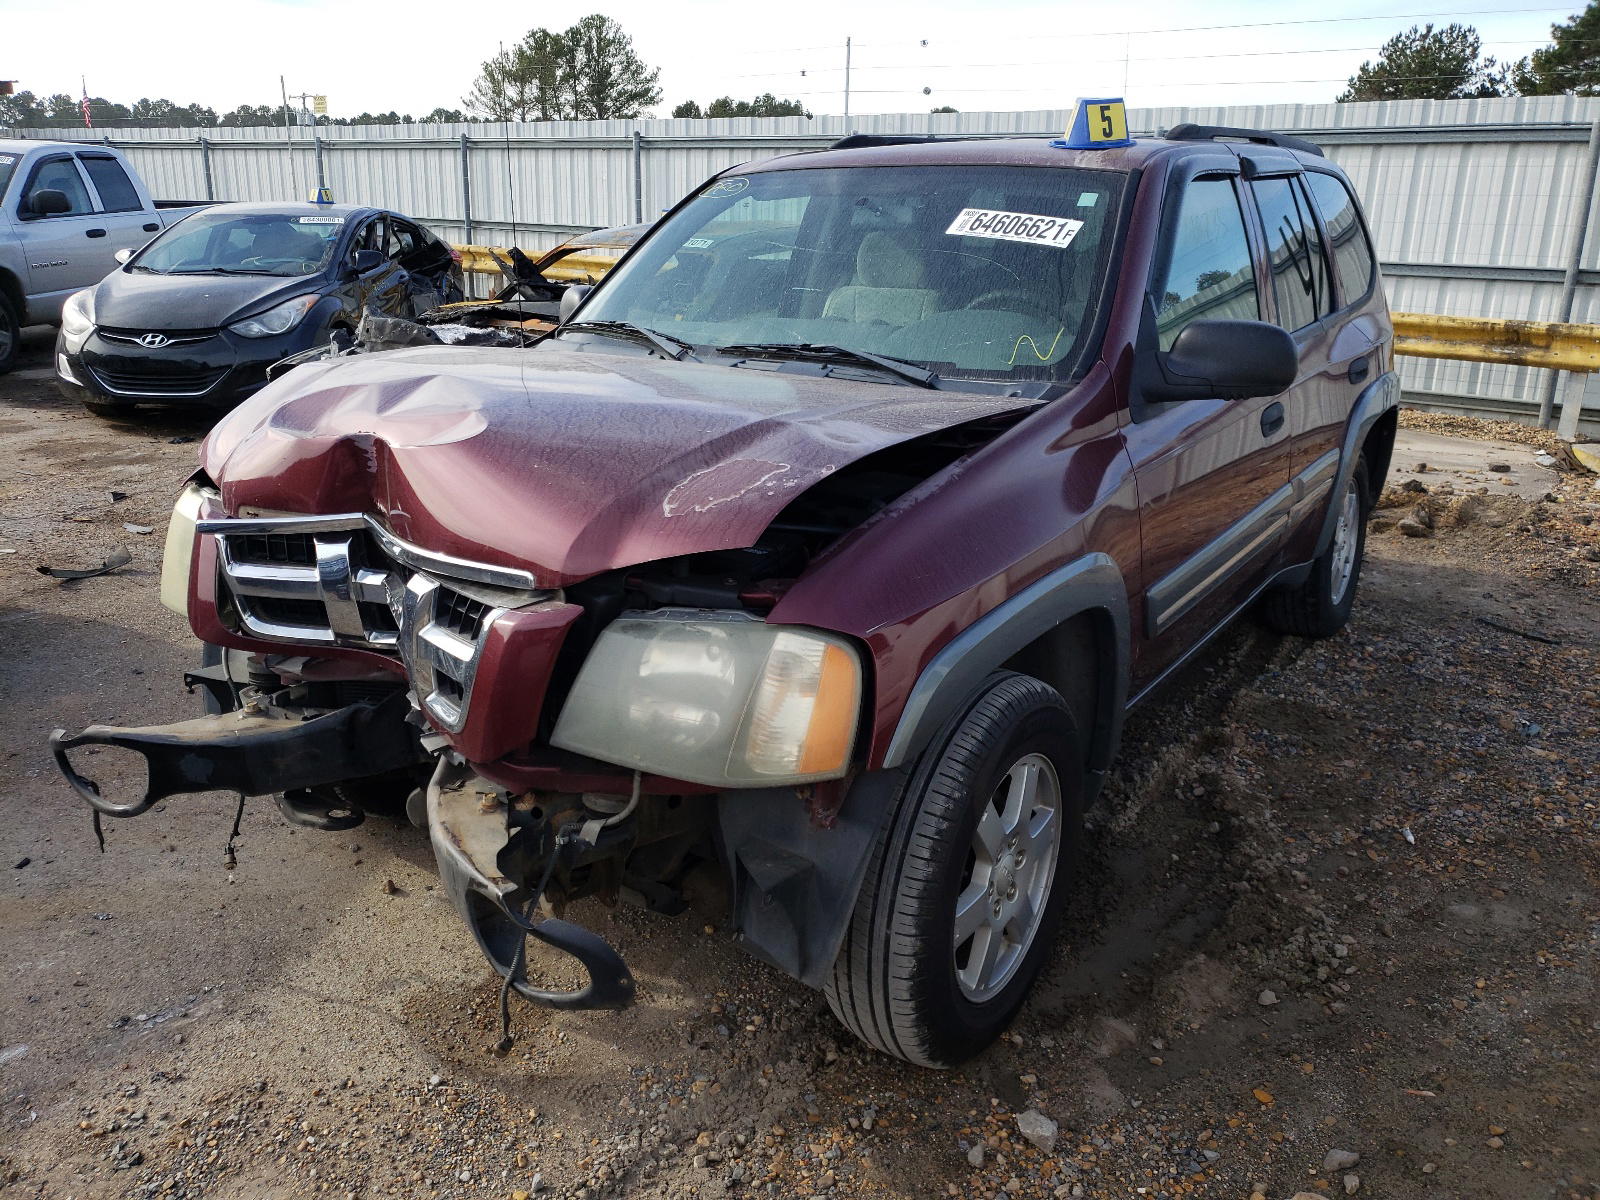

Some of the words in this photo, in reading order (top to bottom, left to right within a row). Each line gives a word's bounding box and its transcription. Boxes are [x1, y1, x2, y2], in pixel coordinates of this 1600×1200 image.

[1099, 105, 1113, 138] 5
[968, 211, 1069, 241] 64606621
[1062, 229, 1075, 240] F
